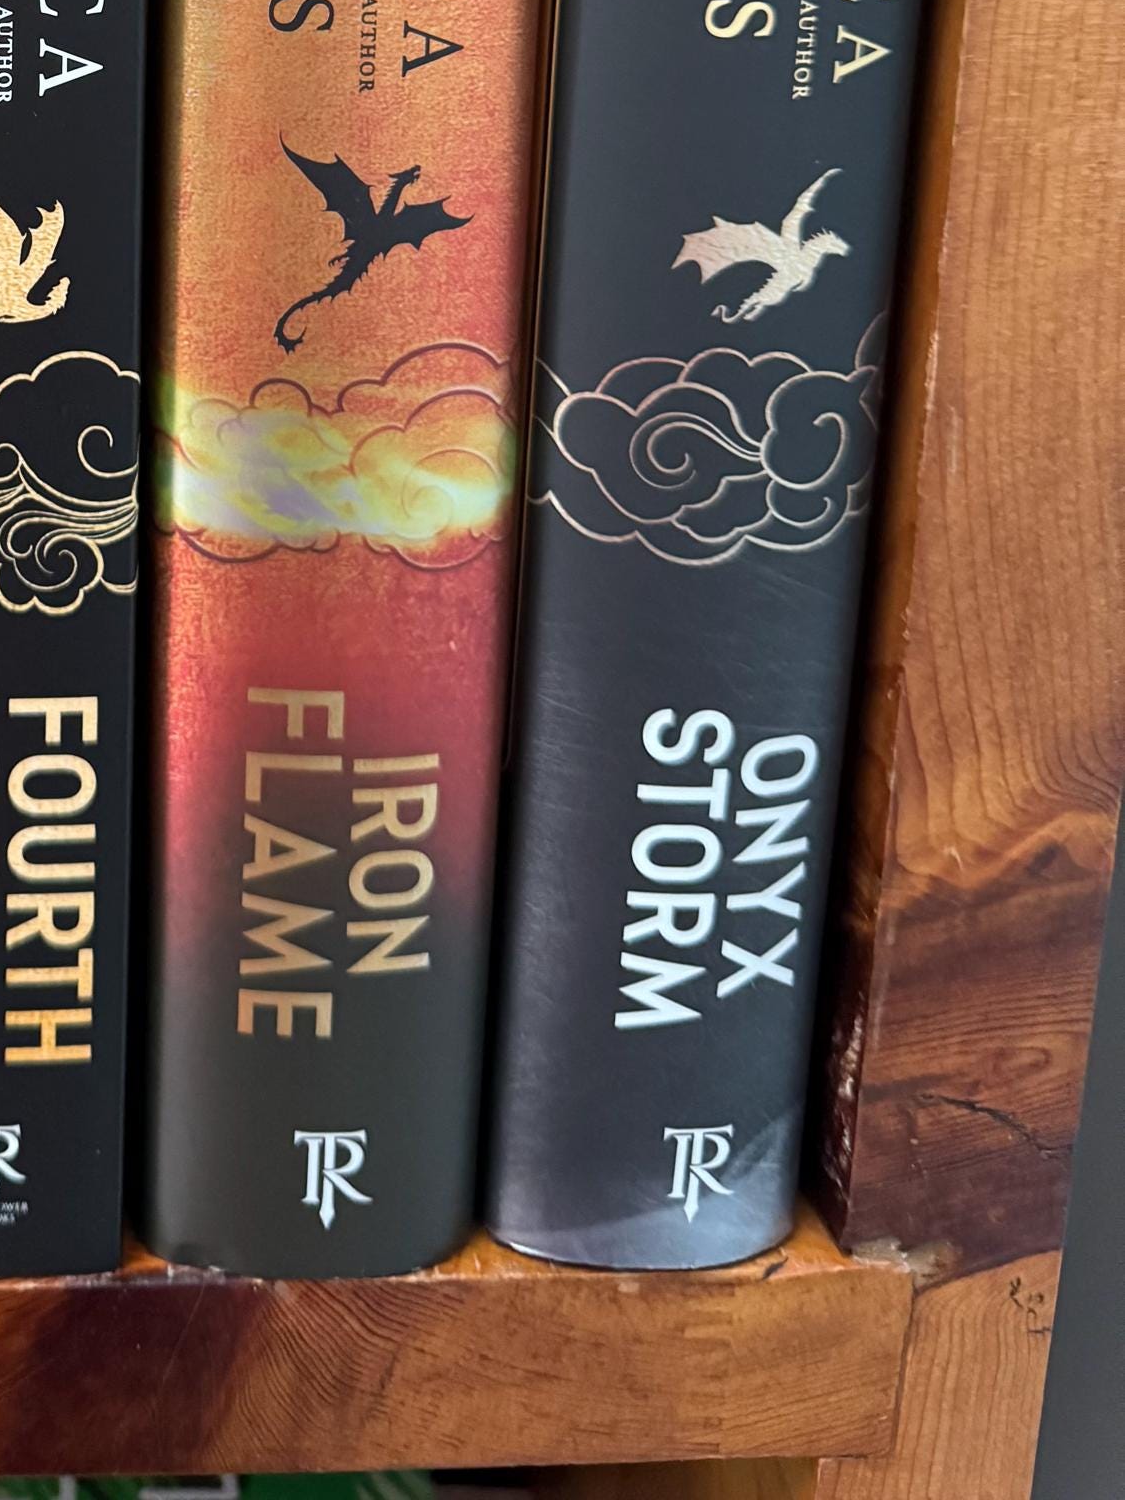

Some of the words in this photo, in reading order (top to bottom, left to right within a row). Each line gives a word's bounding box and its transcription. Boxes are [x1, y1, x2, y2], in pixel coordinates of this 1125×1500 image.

[791, 0, 819, 101] AUTHOR
[3, 696, 99, 1067] FOURTH
[237, 686, 345, 1039] FLAME
[345, 752, 440, 974] IRON
[614, 708, 735, 1030] STORM
[716, 734, 819, 999] ONYX
